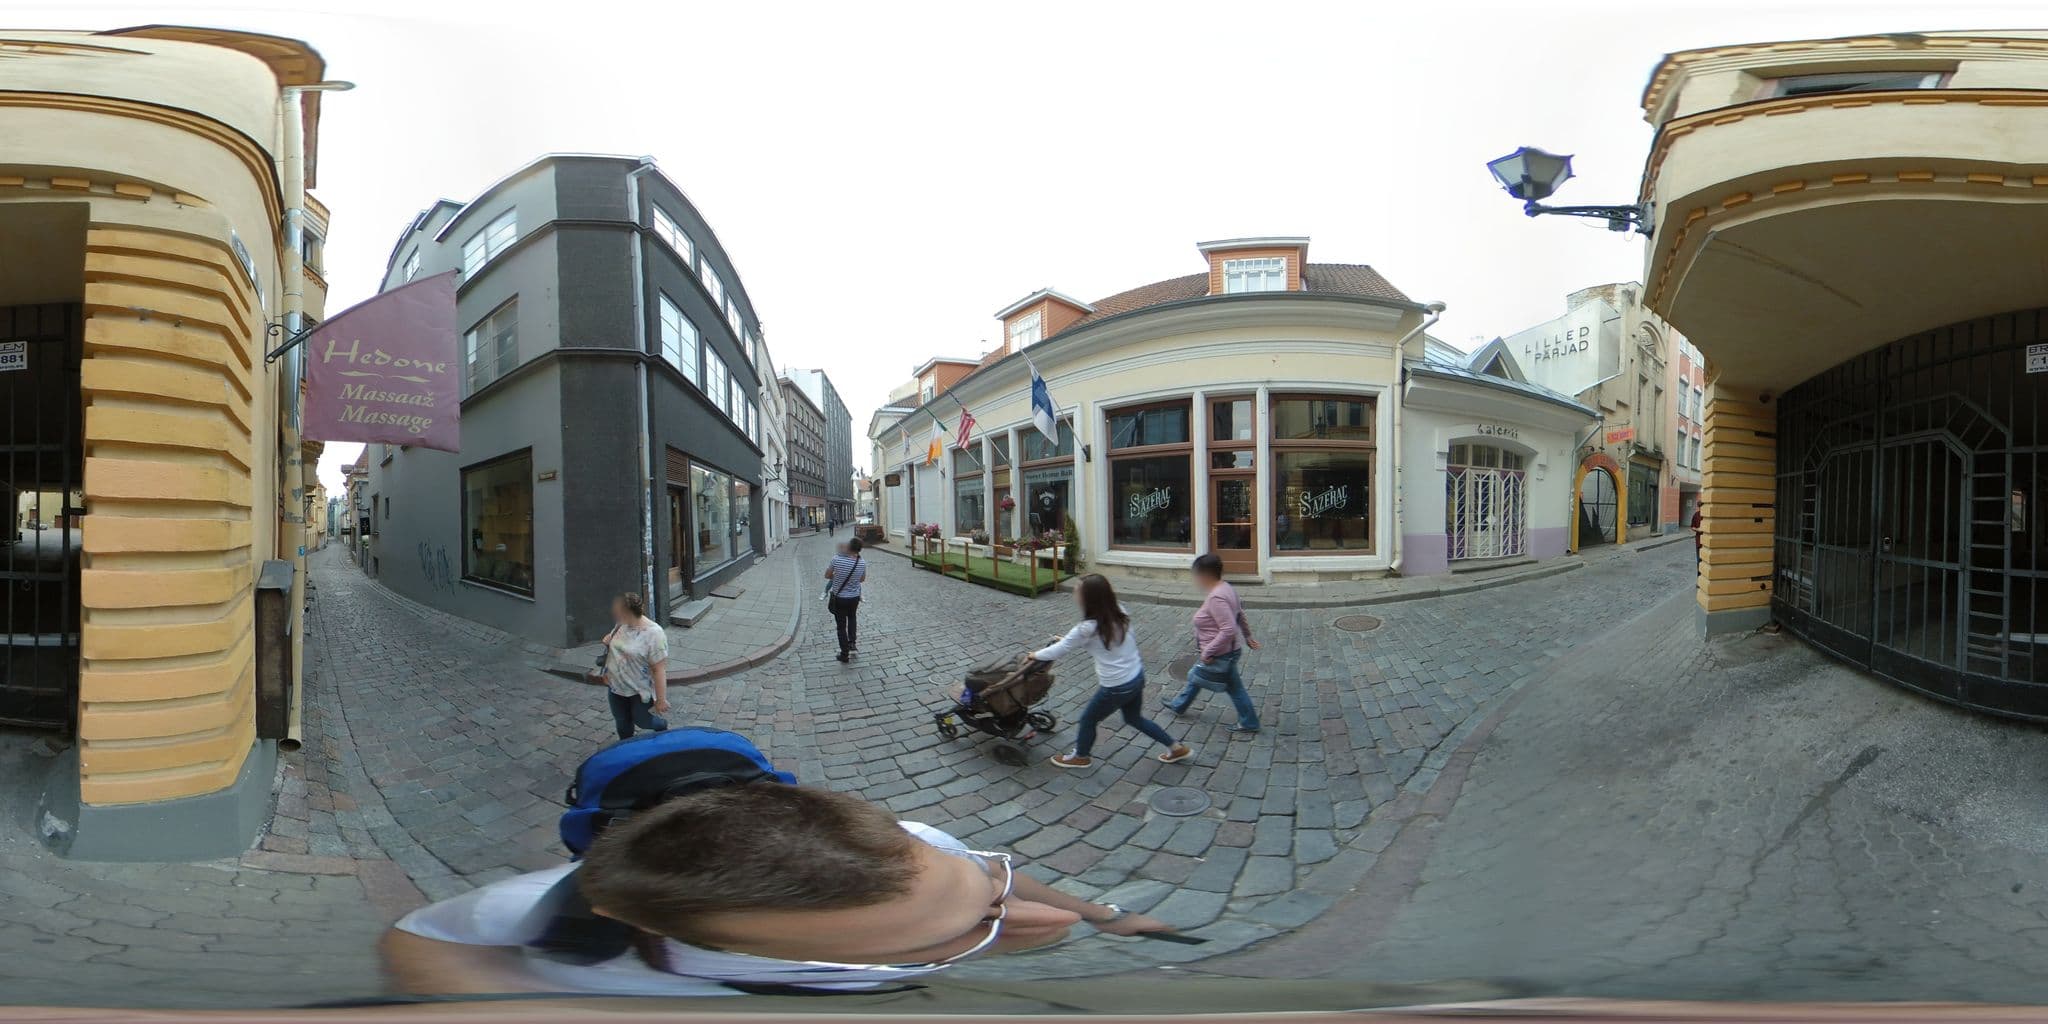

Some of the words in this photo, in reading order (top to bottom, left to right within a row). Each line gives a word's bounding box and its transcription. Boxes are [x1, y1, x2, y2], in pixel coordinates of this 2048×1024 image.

[1525, 326, 1590, 354] LILLED
[1534, 340, 1589, 365] PÄRJAD
[323, 339, 447, 374] Hedone
[337, 383, 434, 407] Massaaž
[337, 404, 433, 434] Massage
[1477, 423, 1518, 440] Galerii
[1129, 486, 1171, 519] SAZERAC
[1298, 484, 1348, 520] SAZERAC
